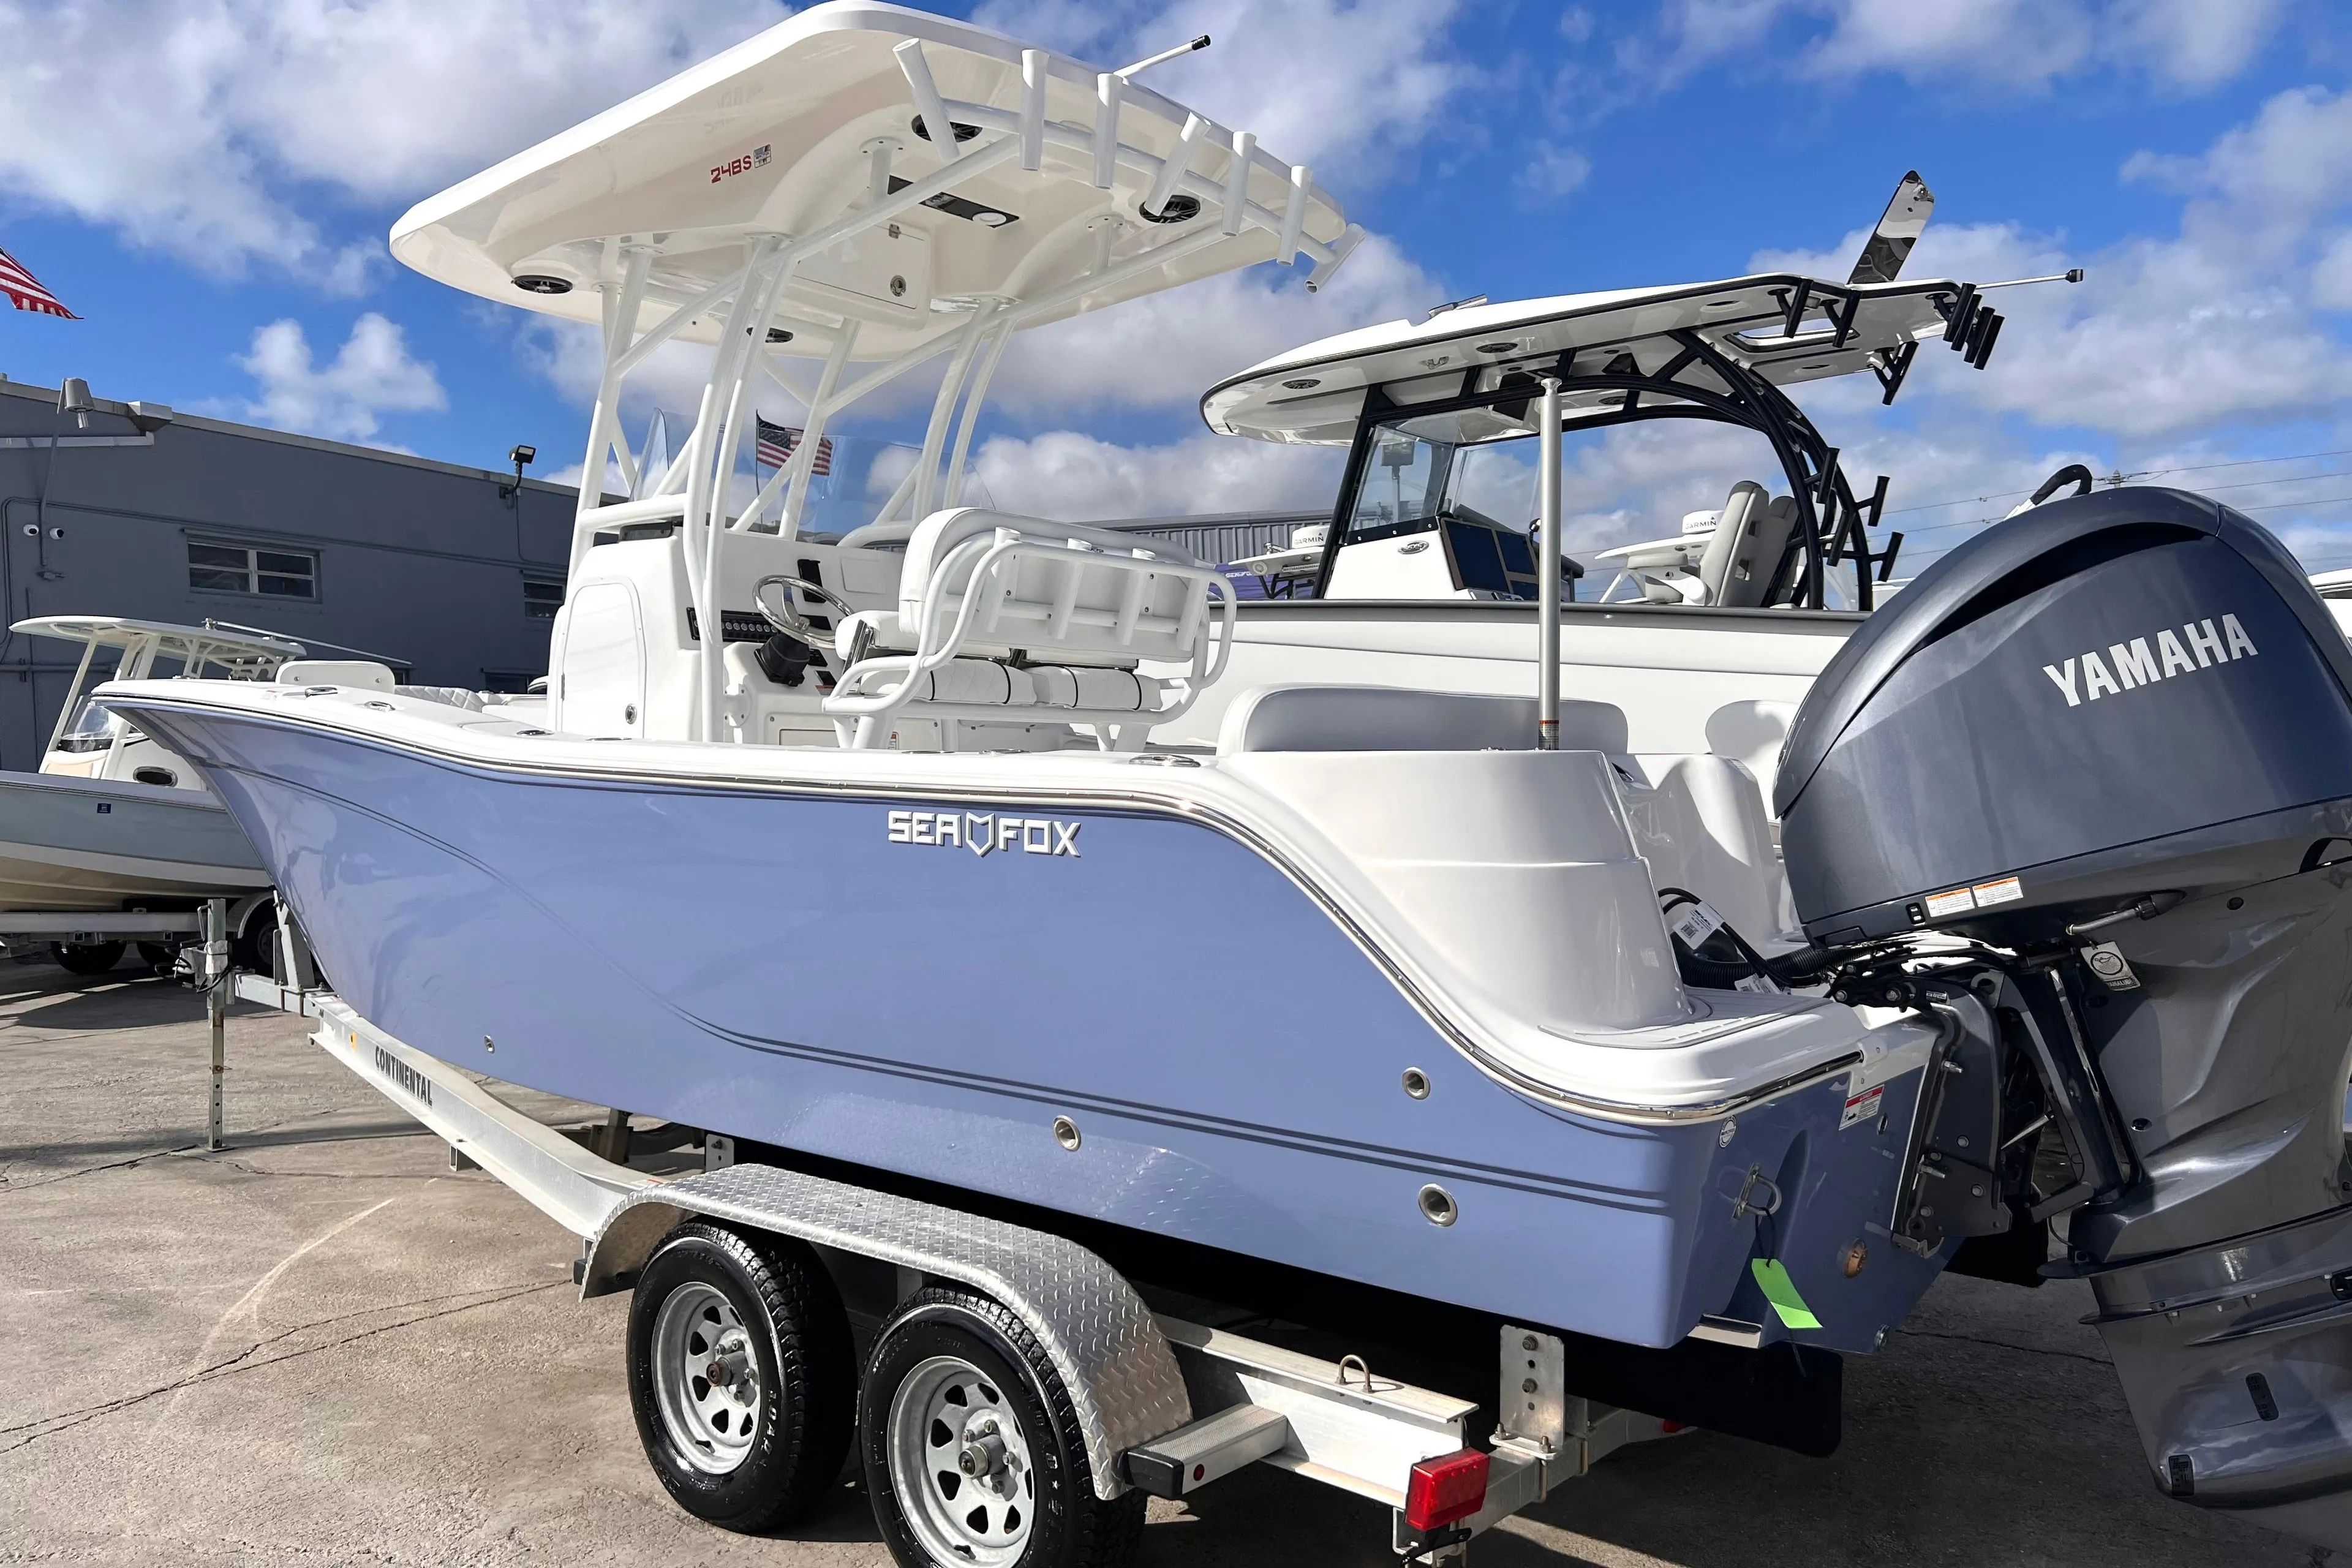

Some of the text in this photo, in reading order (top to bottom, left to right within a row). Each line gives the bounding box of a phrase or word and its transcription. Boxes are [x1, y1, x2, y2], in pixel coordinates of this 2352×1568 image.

[1294, 536, 1324, 545] GARMIN
[1685, 521, 1717, 530] GARMIN
[2042, 612, 2259, 707] YAMAHA
[888, 810, 1082, 858] SEA FOX
[375, 1045, 433, 1107] CONTINENTAL
